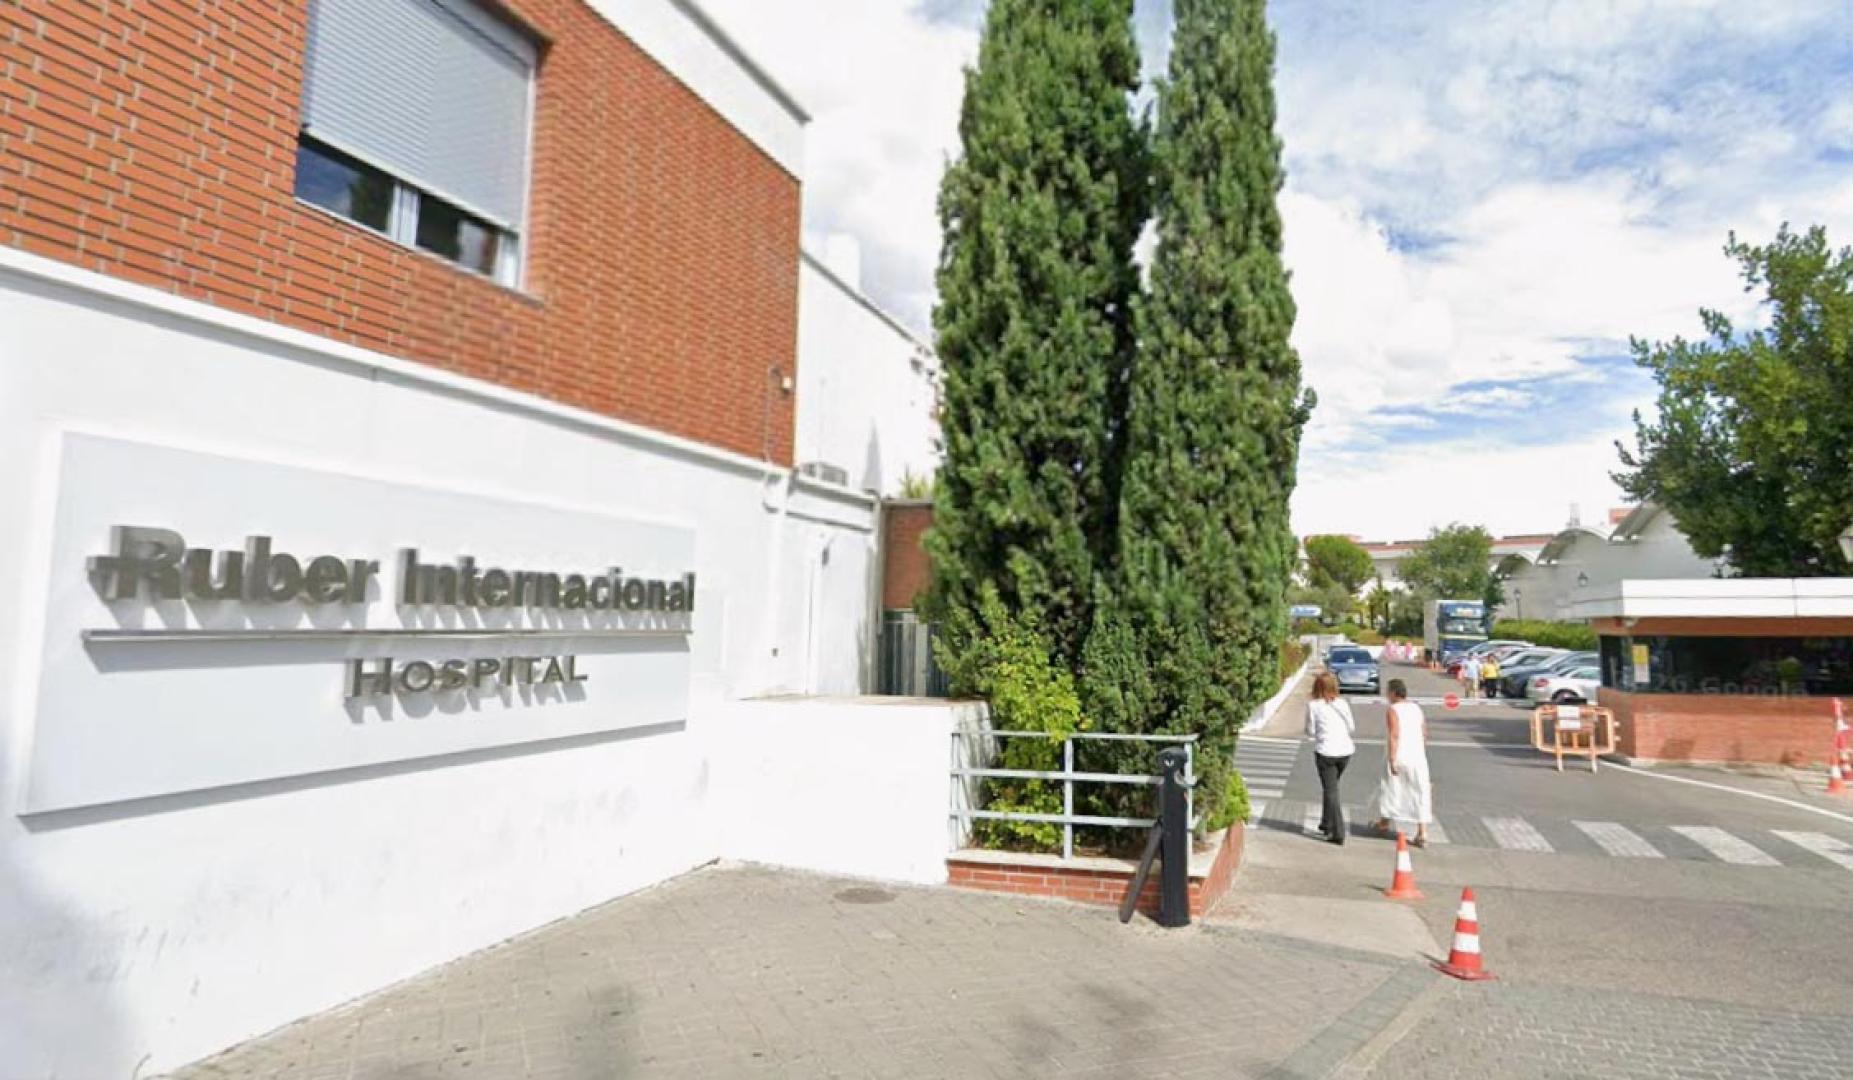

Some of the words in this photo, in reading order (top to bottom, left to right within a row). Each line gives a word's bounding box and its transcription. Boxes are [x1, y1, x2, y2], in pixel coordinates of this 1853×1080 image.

[86, 525, 380, 603] Ruber
[398, 548, 695, 612] Internacional
[348, 655, 588, 697] HOSPITAL
